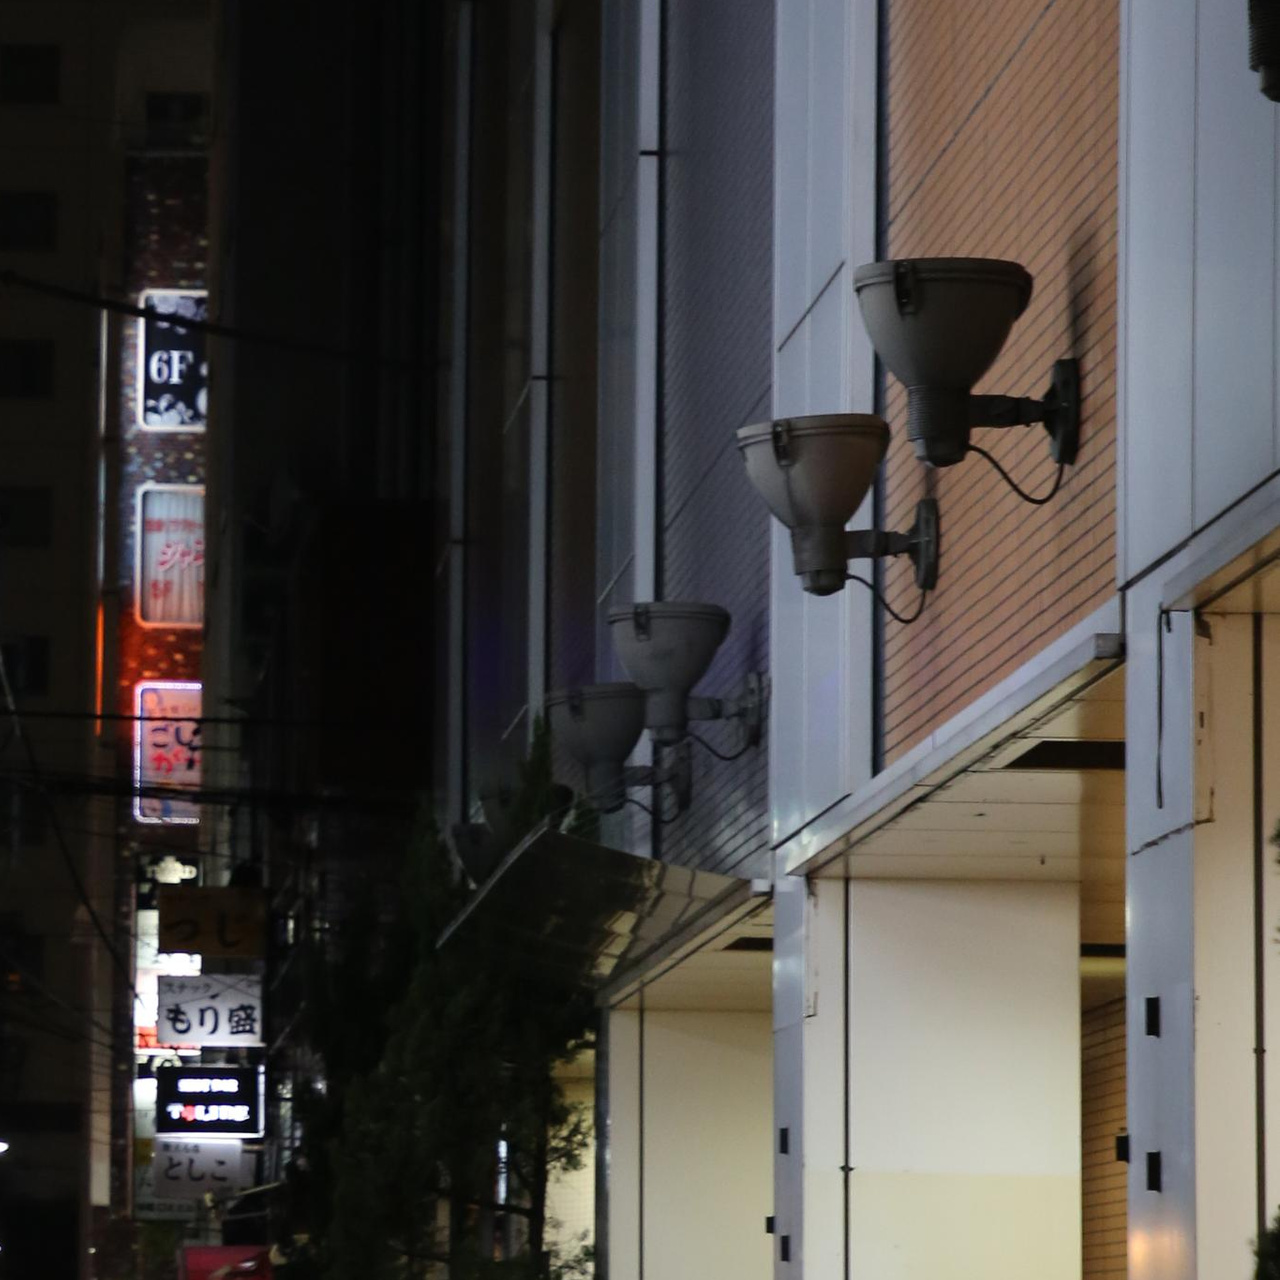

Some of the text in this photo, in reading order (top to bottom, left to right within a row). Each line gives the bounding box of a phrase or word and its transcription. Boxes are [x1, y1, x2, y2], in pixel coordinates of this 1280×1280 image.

[149, 349, 195, 385] 6F
[166, 1003, 258, 1035] もり盛
[164, 1156, 228, 1182] としこ
